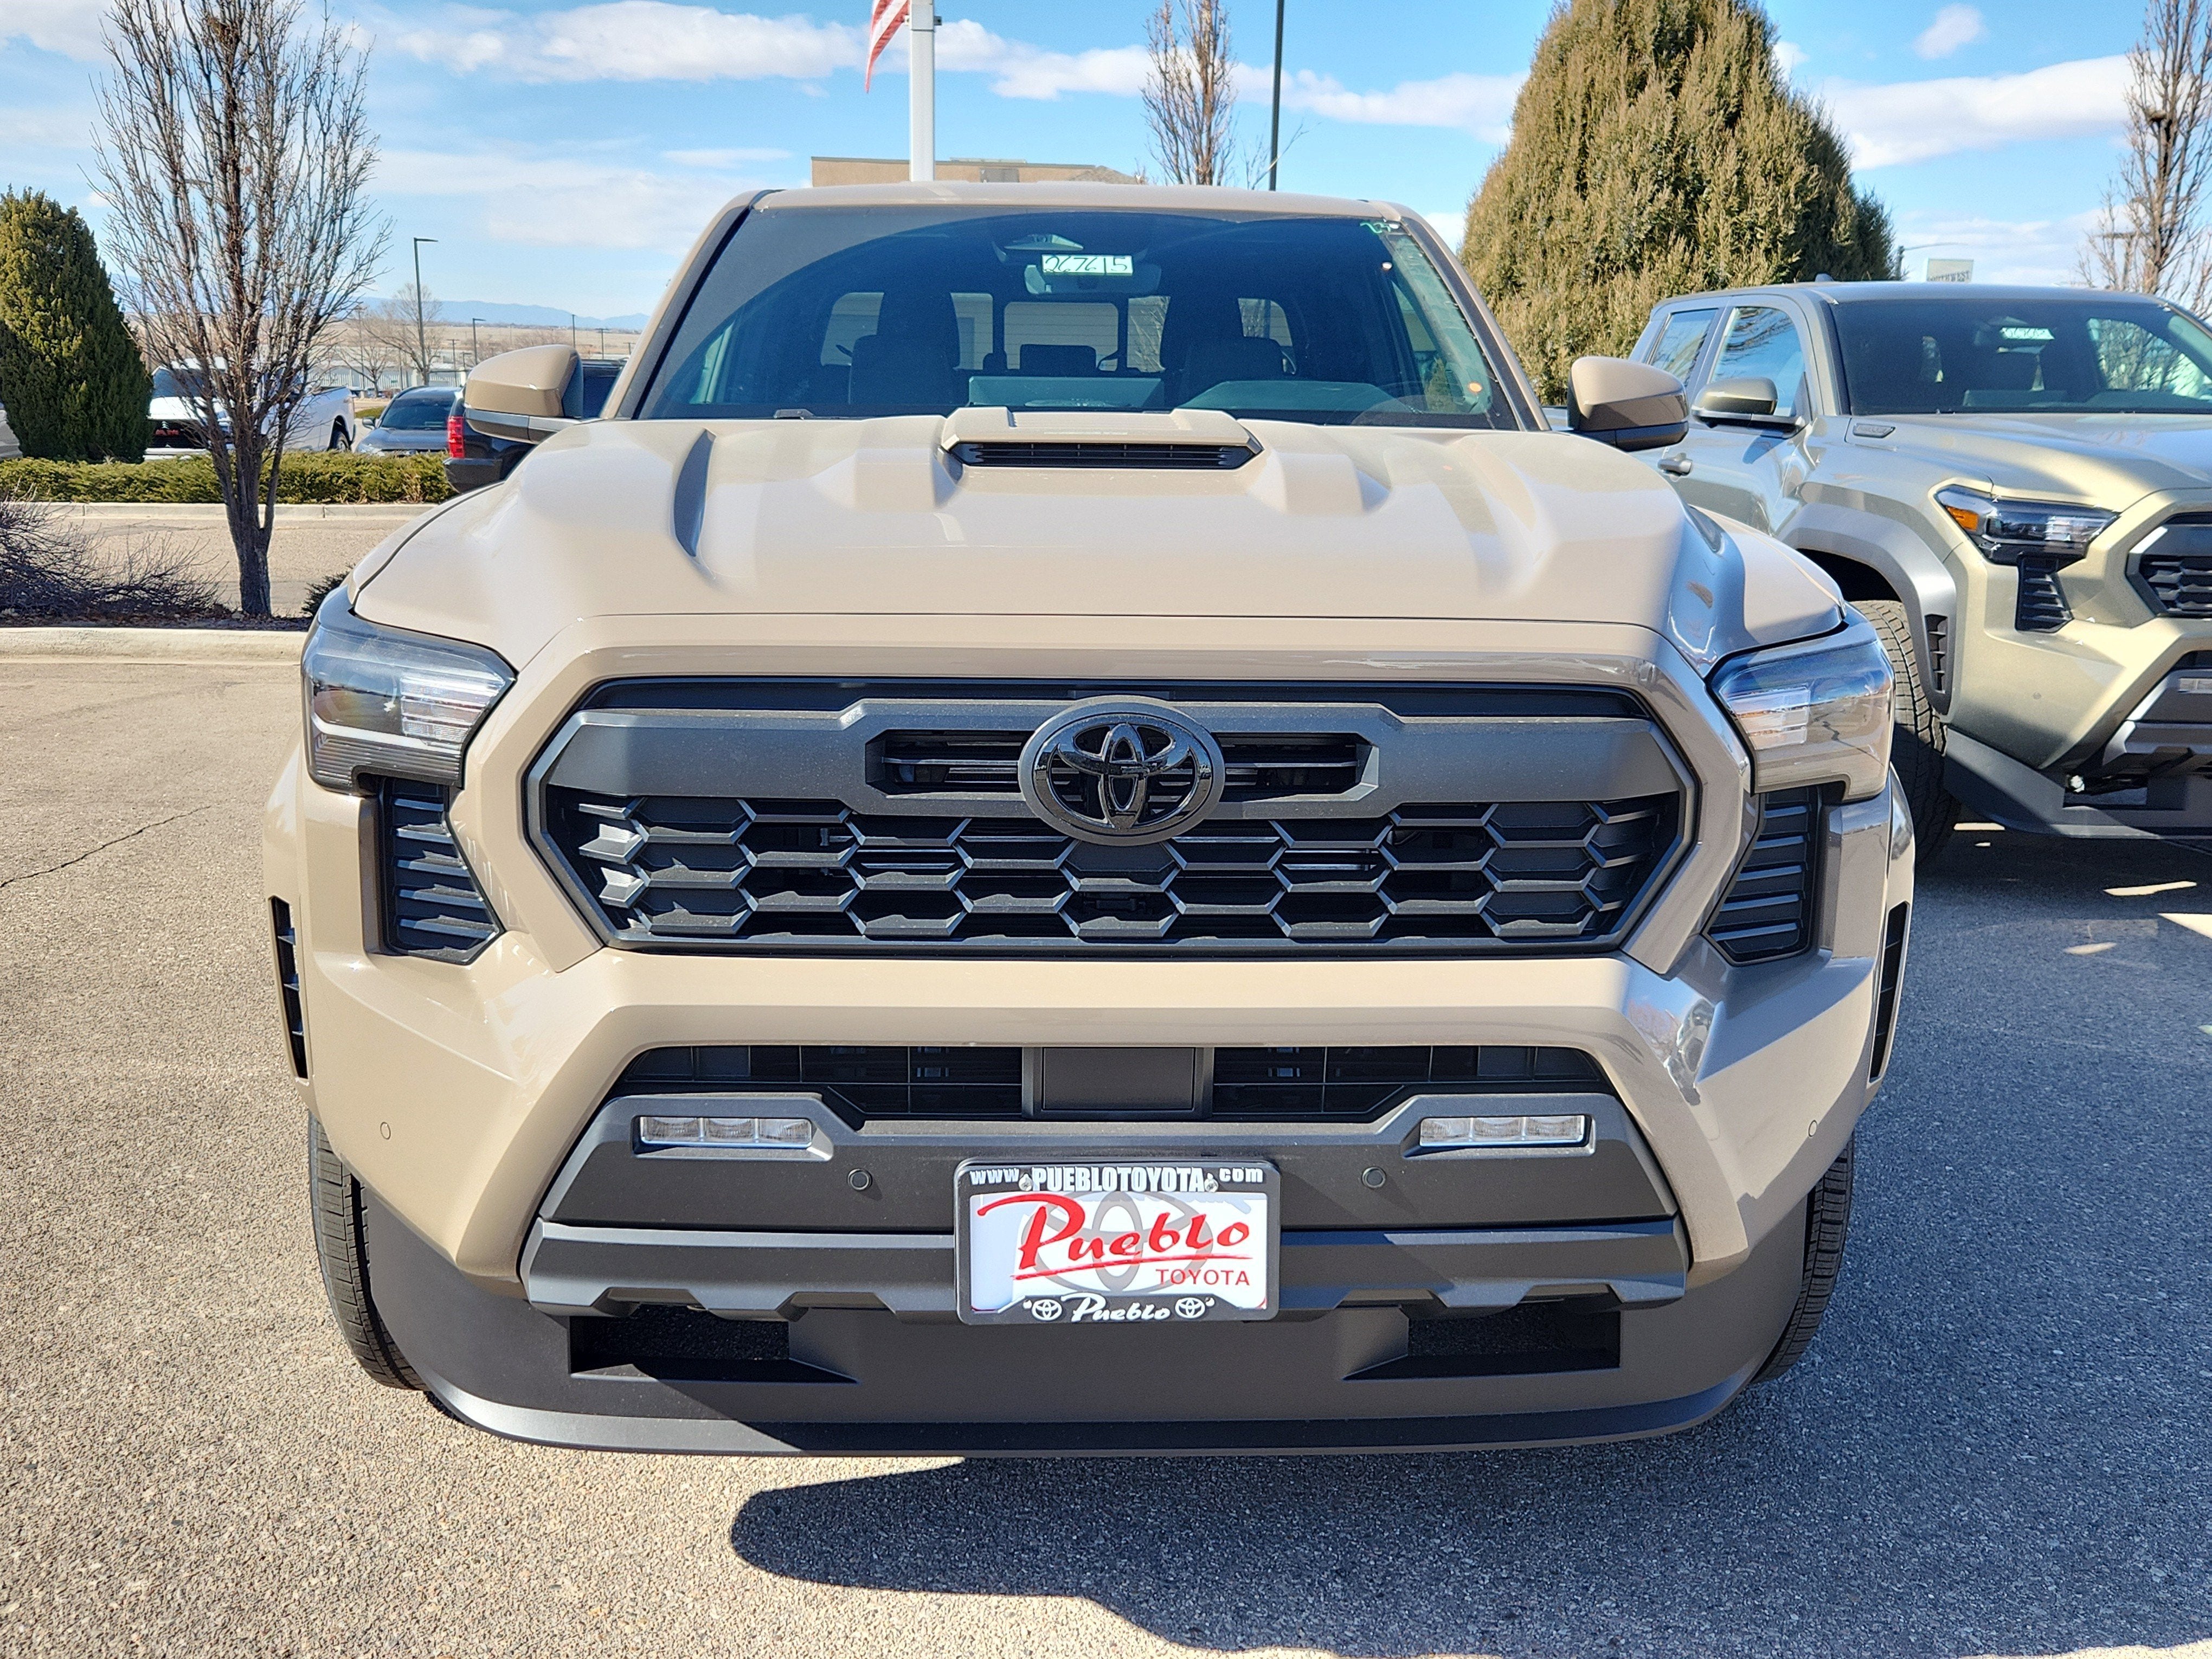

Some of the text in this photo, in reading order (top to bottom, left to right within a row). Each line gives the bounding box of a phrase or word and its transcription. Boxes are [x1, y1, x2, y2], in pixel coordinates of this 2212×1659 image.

[969, 1168, 1020, 1185] www
[1032, 1166, 1205, 1192] PUEBLOTOYOTA
[977, 1193, 1249, 1270] Pueblo
[1155, 1269, 1250, 1286] TOYOTA
[1060, 1292, 1171, 1322] Pueblo
